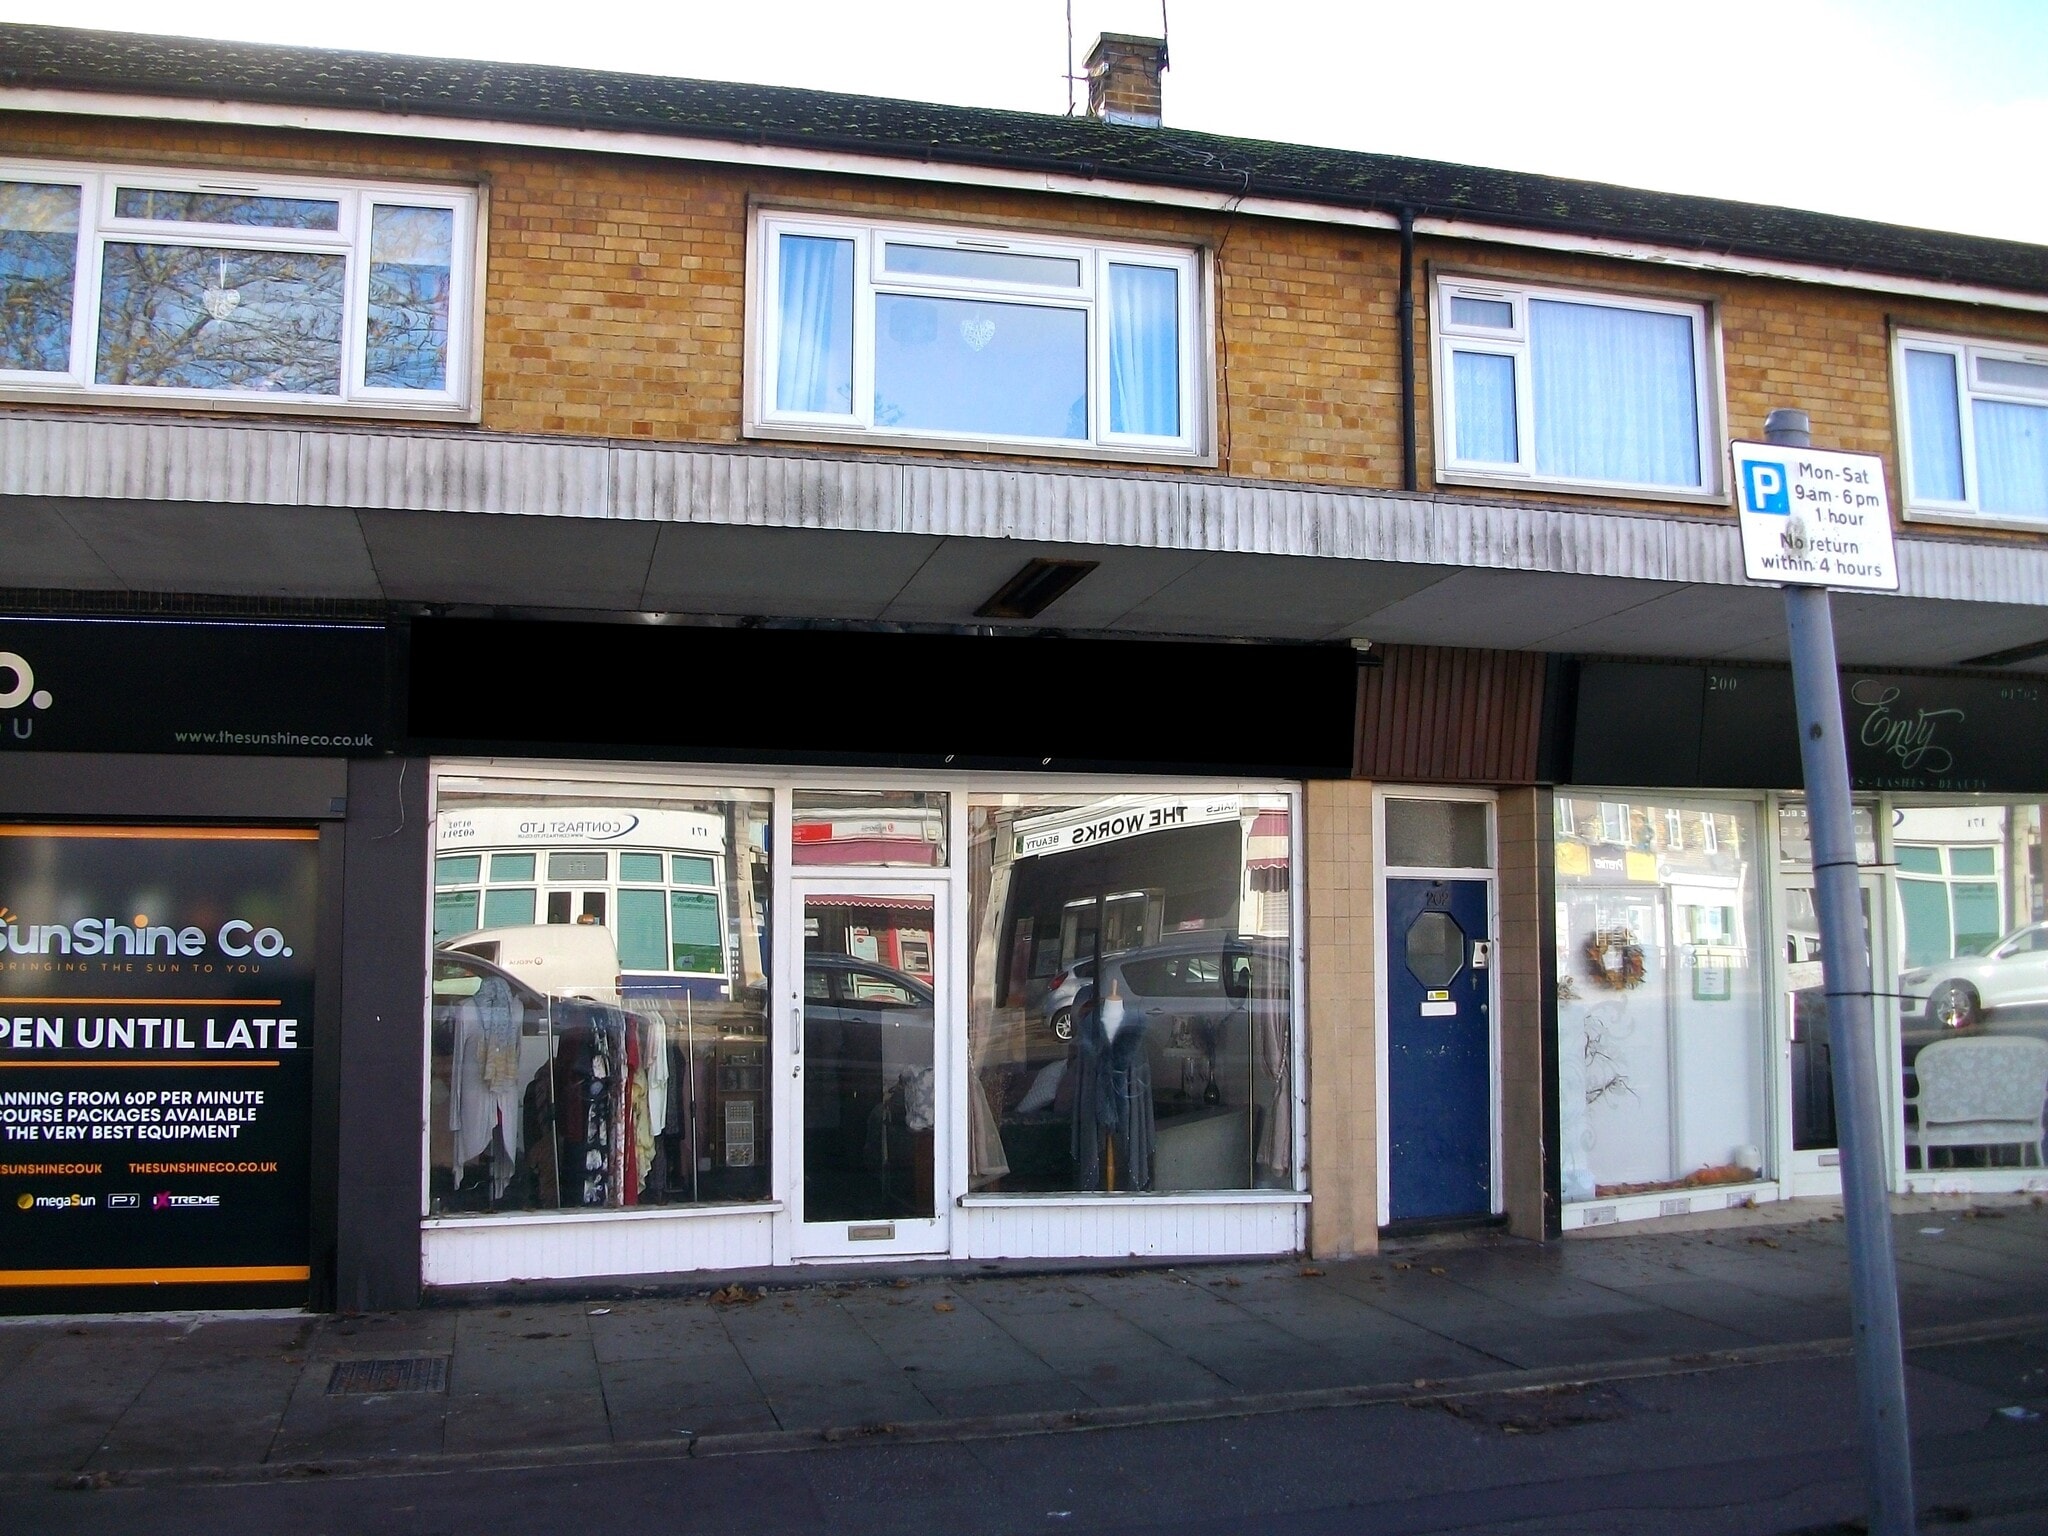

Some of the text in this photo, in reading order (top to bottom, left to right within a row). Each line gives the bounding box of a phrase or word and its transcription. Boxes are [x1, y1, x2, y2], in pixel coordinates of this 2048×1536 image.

[1816, 508, 1864, 526] 1 hour
[1780, 532, 1859, 554] No return
[1761, 554, 1882, 578] within 4 hours
[1709, 676, 1737, 691] 200
[1851, 679, 1964, 773] Envy
[175, 730, 374, 747] www.thesunshineco.co.uk
[0, 914, 293, 957] unShine Co.
[101, 963, 133, 972] THE
[146, 963, 180, 973] SUN
[193, 964, 213, 973] TO
[226, 965, 260, 974] YOU
[77, 1018, 196, 1050] UNTIL
[206, 1019, 298, 1049] LATE
[0, 1091, 265, 1106] NNING FROM 60P PER MINUTE
[0, 1108, 257, 1123] OURSE PACKAGES AVAILABLE
[6, 1125, 241, 1140] THE VERY BEST EQUIPMENT
[0, 1161, 278, 1175] SUNSHINECOUK THESUNSHINECO.CO.UK
[36, 1194, 96, 1210] megaSun
